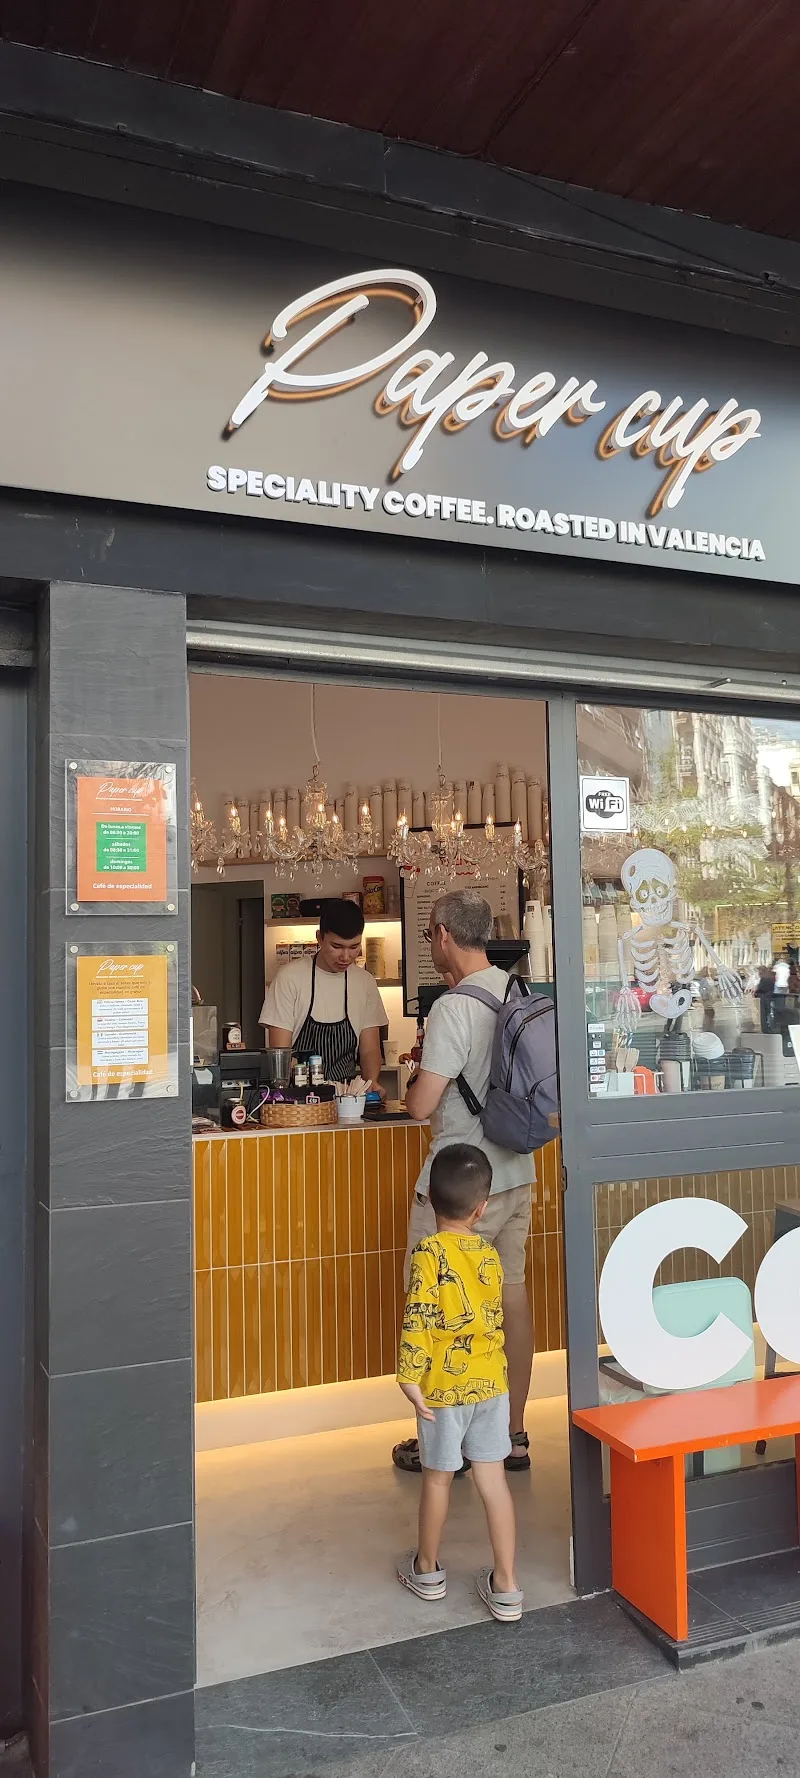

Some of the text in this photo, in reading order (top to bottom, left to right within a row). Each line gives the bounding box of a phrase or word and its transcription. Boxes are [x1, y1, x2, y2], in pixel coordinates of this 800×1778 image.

[231, 268, 761, 508] Paper cup
[207, 465, 765, 561] SPECIALITY COFFEE. ROASTED IN VALENCIA
[97, 781, 127, 797] Paper
[115, 882, 152, 891] especialidad
[97, 958, 127, 976] Paper
[92, 1069, 107, 1078] Café
[116, 1069, 153, 1077] especialidad
